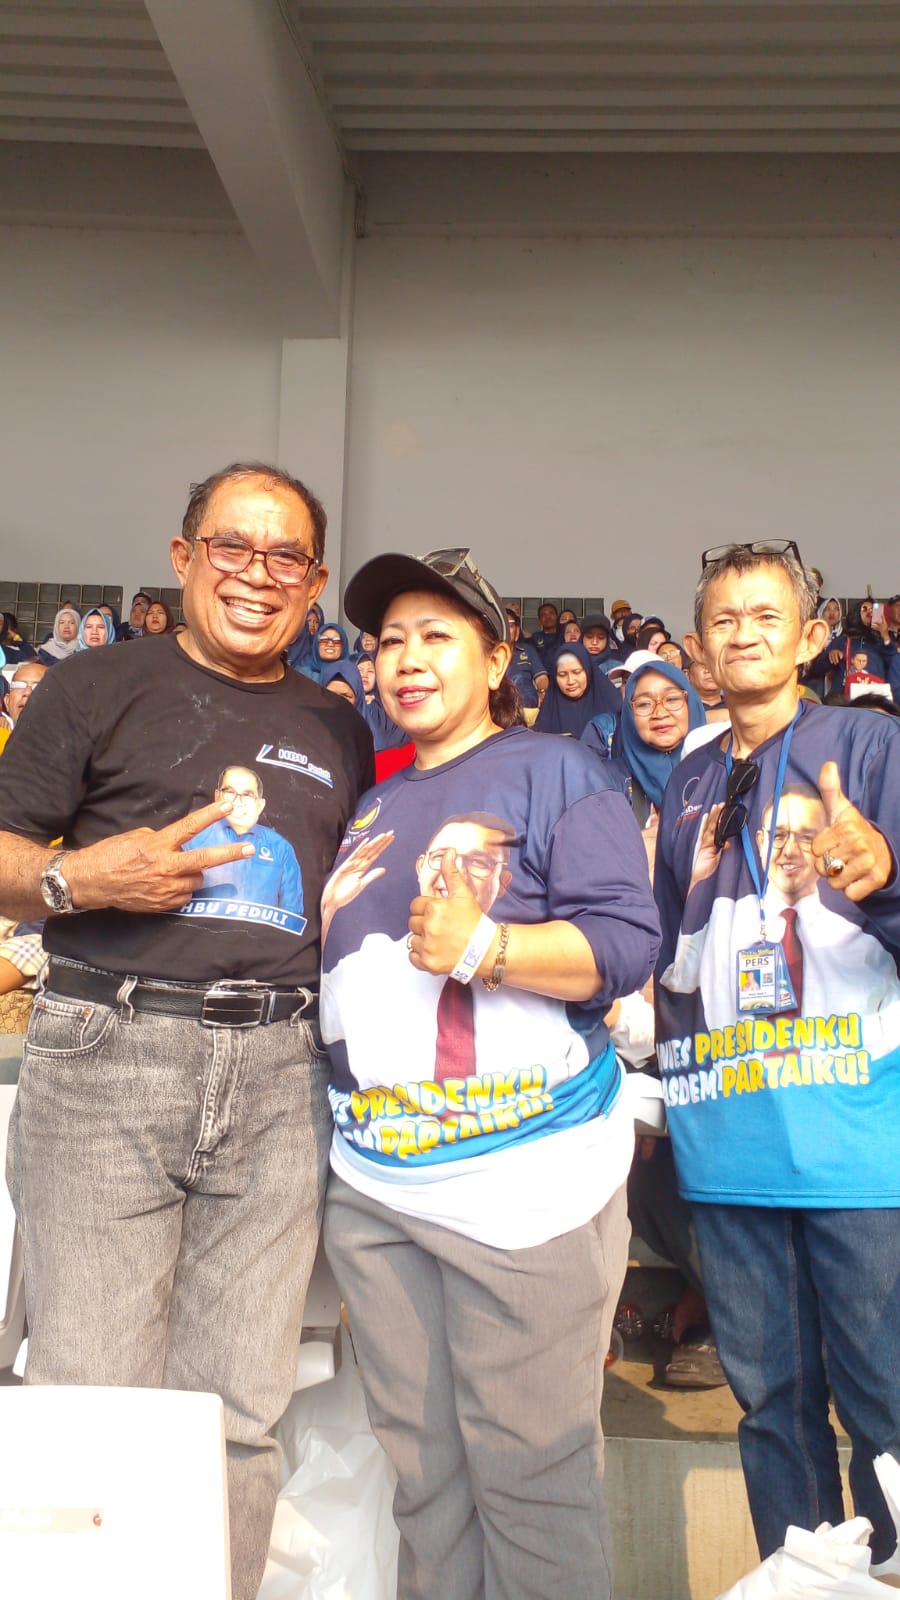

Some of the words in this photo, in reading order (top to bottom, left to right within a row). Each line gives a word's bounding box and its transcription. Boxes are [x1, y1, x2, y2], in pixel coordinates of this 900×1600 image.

[180, 901, 220, 914] HBU
[223, 902, 288, 925] PEDULI
[745, 956, 769, 967] PERS
[655, 1036, 692, 1072] NIES
[694, 1012, 863, 1064] PRESIDENKU
[722, 1050, 870, 1098] PARTAIKU!
